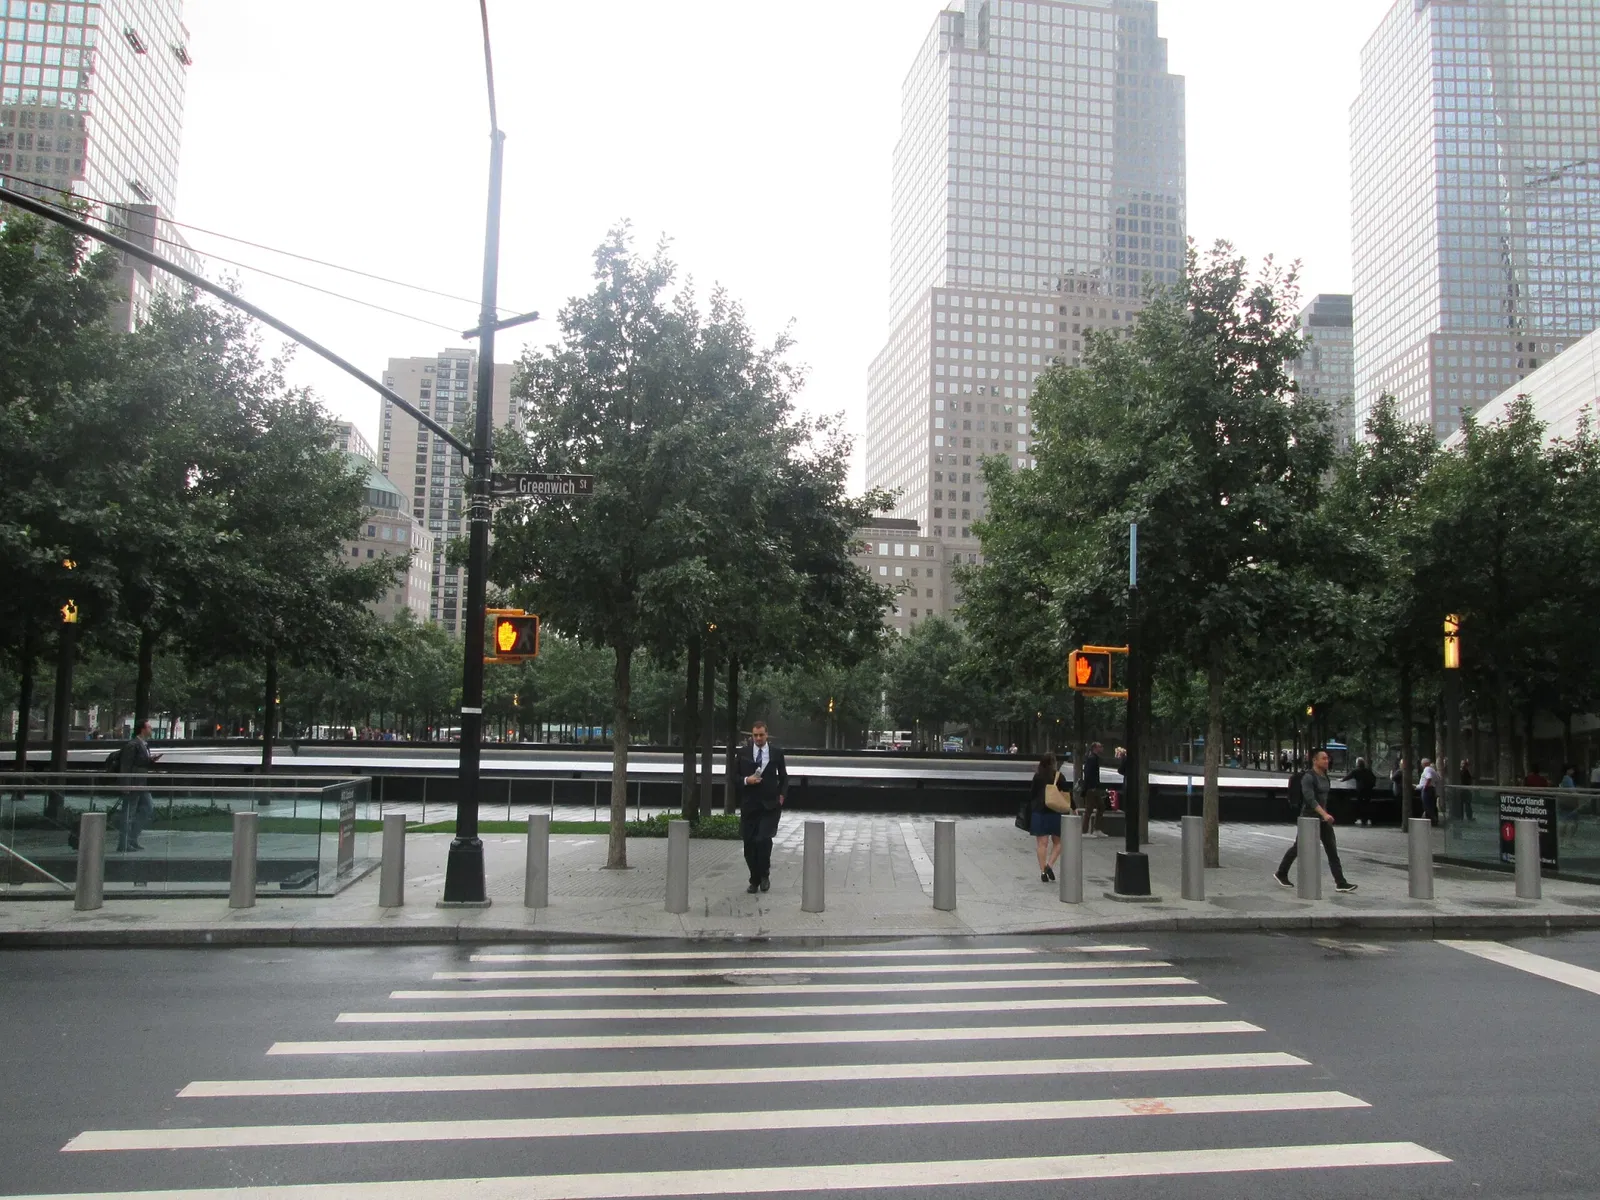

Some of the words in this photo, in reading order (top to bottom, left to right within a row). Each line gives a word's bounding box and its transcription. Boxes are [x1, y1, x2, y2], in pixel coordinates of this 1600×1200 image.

[519, 477, 575, 494] Greenwich
[579, 479, 588, 489] St
[1500, 795, 1515, 804] WTC
[1515, 796, 1545, 806] Cortlandt
[1500, 803, 1524, 815] Subway
[1525, 805, 1547, 815] Station
[1505, 826, 1510, 837] 1
